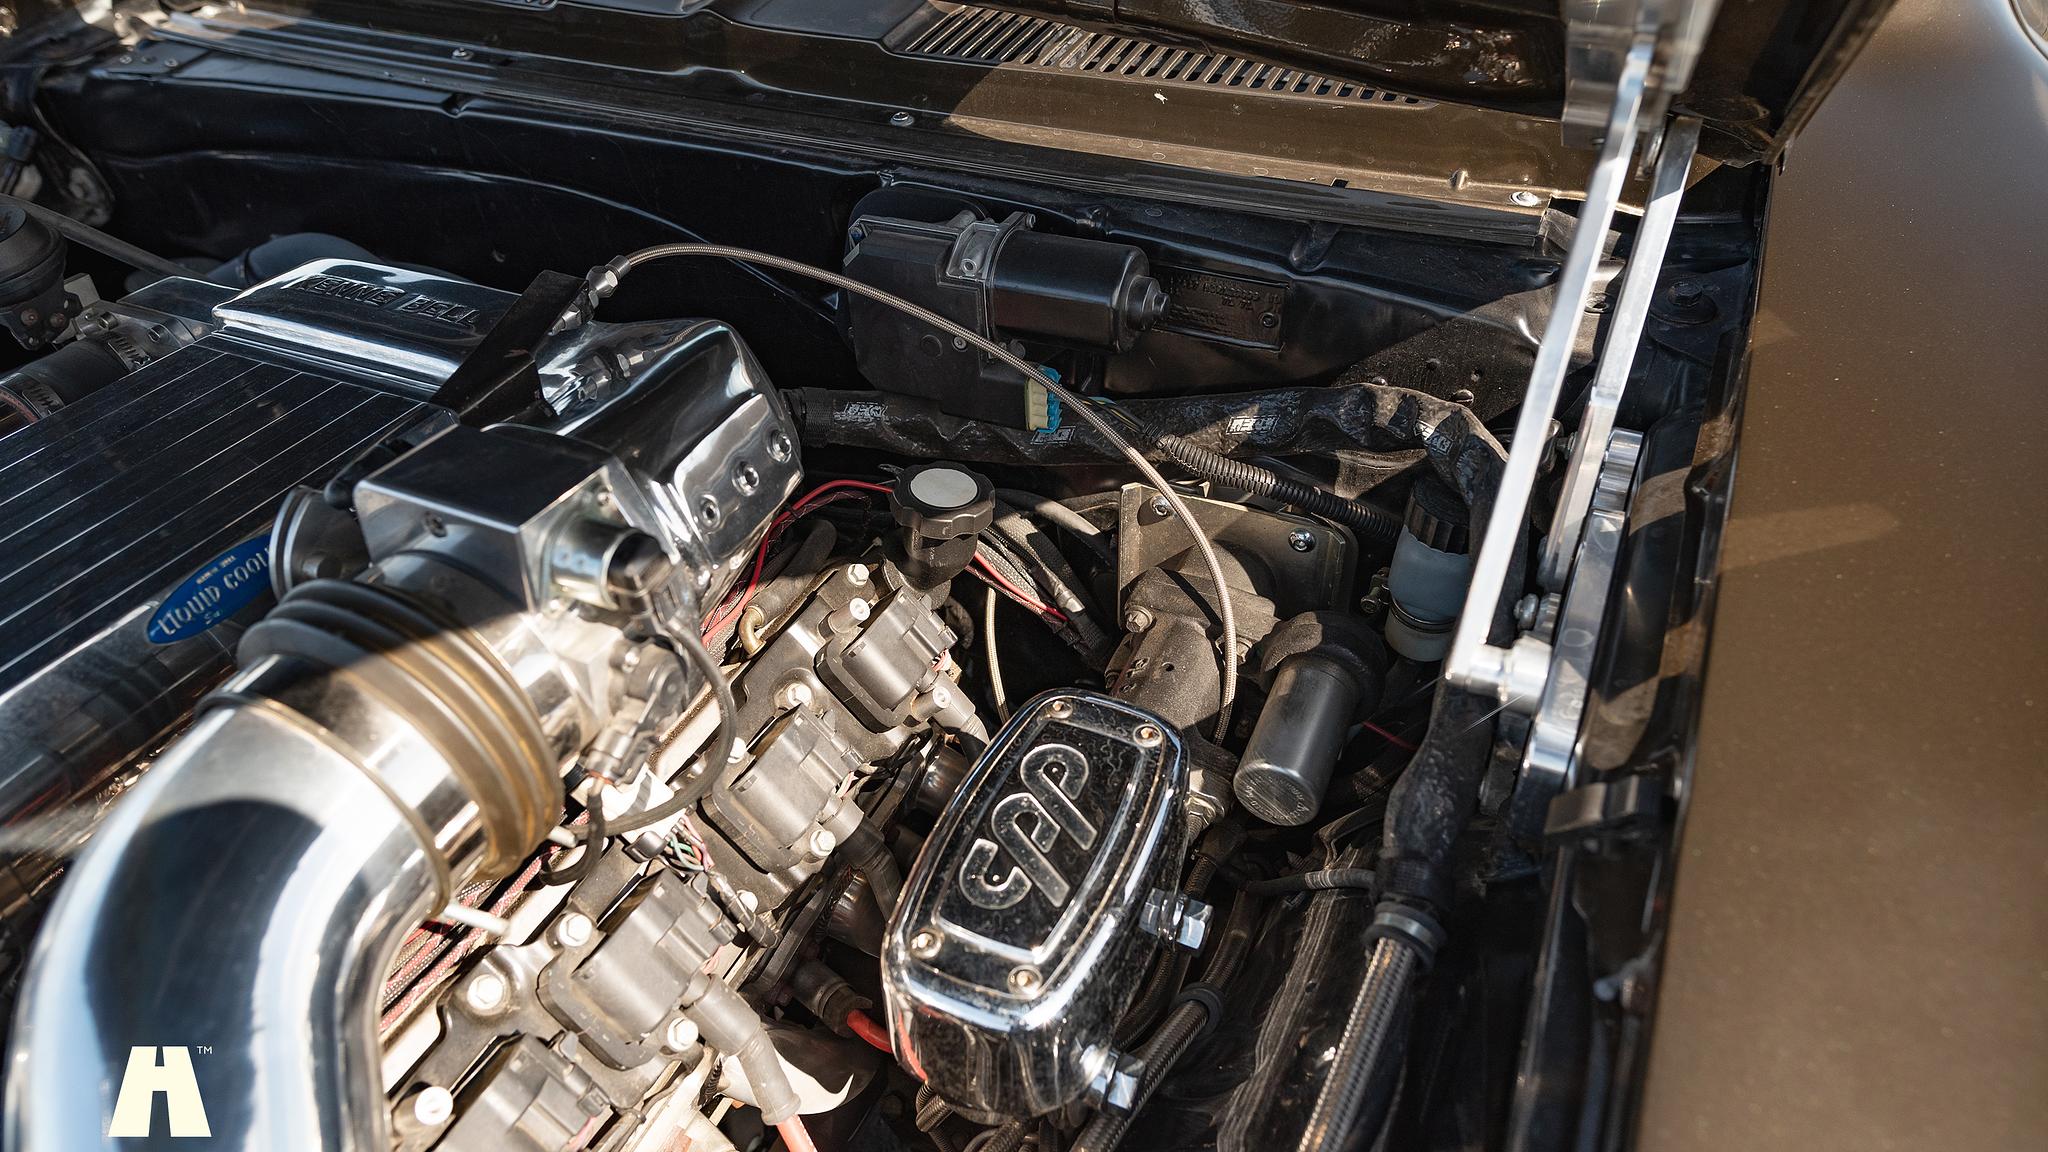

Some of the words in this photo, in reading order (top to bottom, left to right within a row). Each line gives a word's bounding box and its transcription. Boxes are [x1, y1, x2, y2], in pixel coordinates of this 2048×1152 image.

[281, 274, 404, 307] KENNE
[396, 295, 480, 328] BELL
[158, 585, 221, 636] LIQUID
[223, 547, 271, 591] COOL
[958, 743, 1098, 909] CPP
